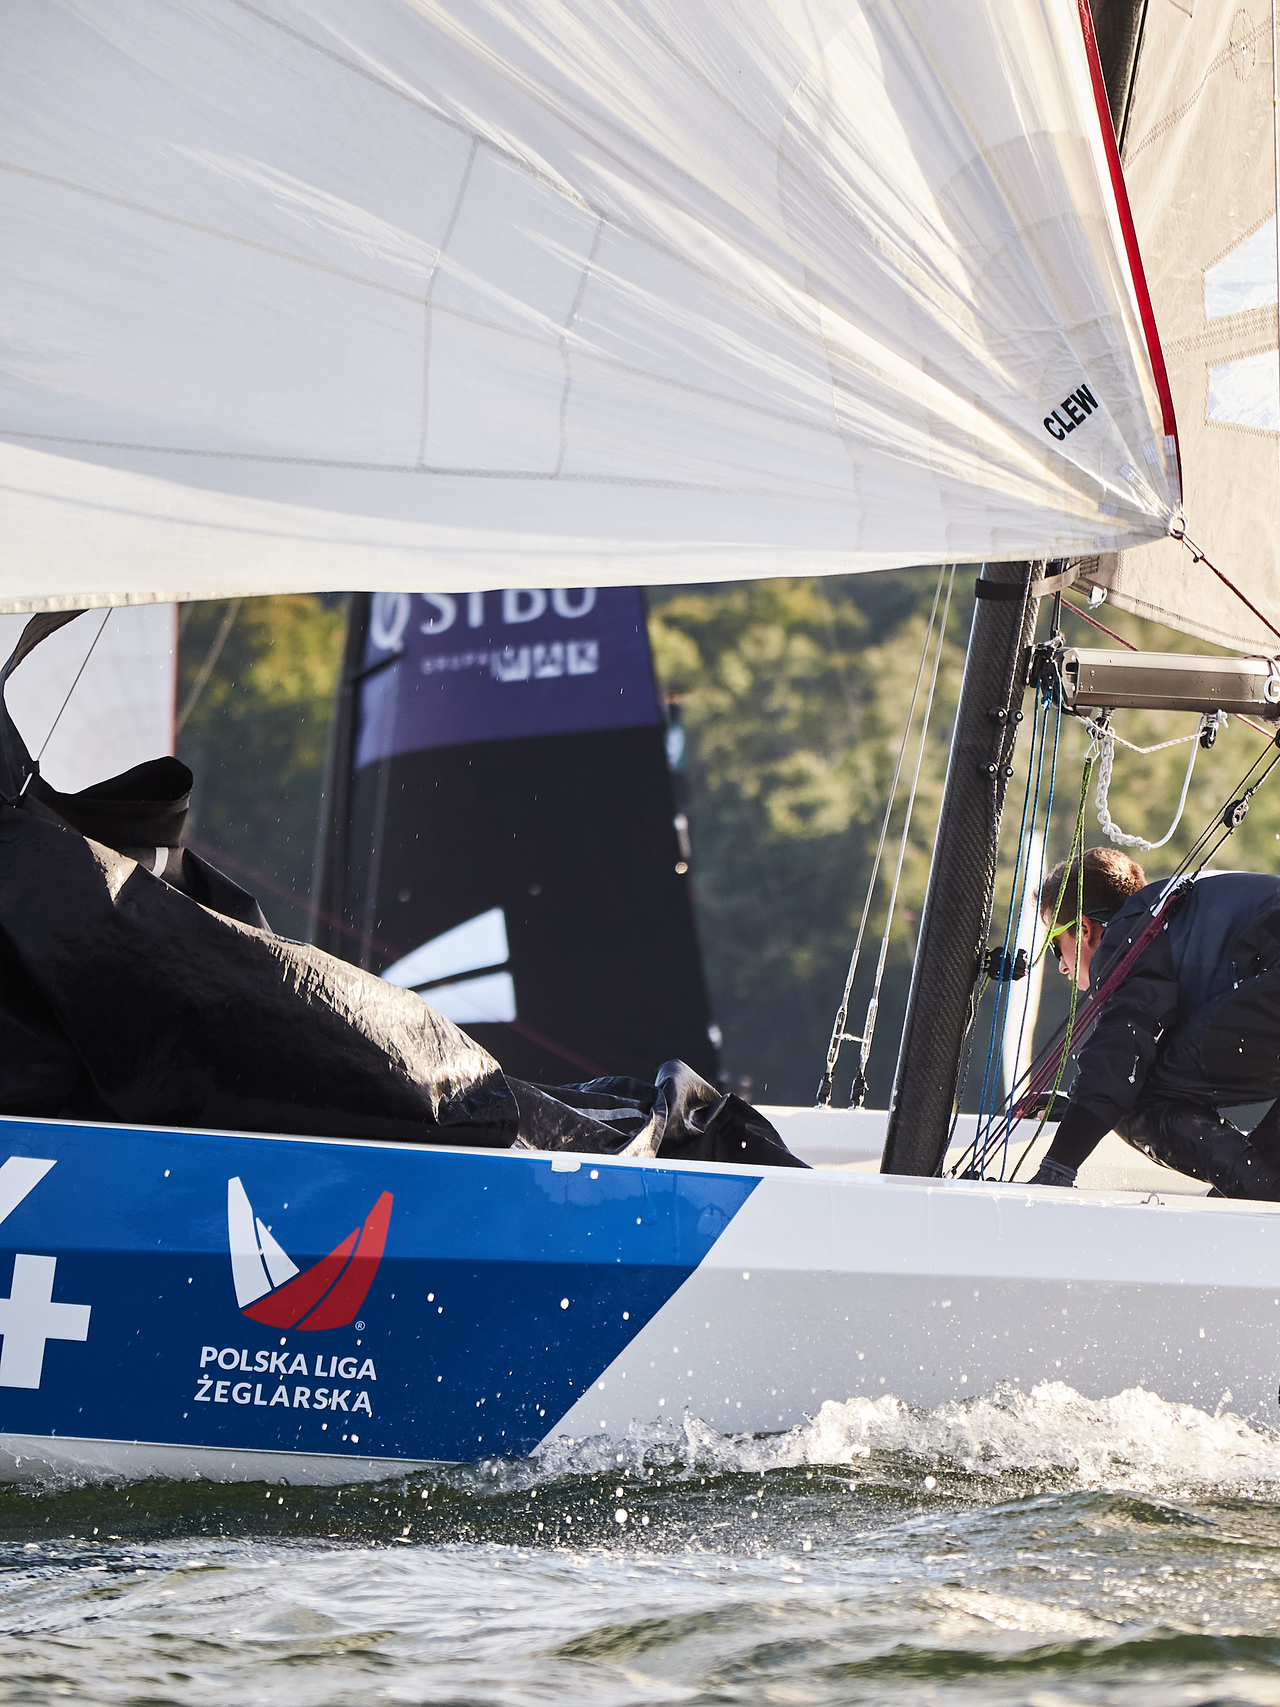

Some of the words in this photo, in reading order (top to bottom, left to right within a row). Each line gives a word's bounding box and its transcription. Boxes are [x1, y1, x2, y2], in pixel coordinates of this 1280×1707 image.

[1043, 383, 1098, 441] CLEW
[199, 1346, 309, 1376] POLSKA
[314, 1354, 377, 1381] LIGA
[193, 1373, 373, 1413] ŻEGLARSKA
